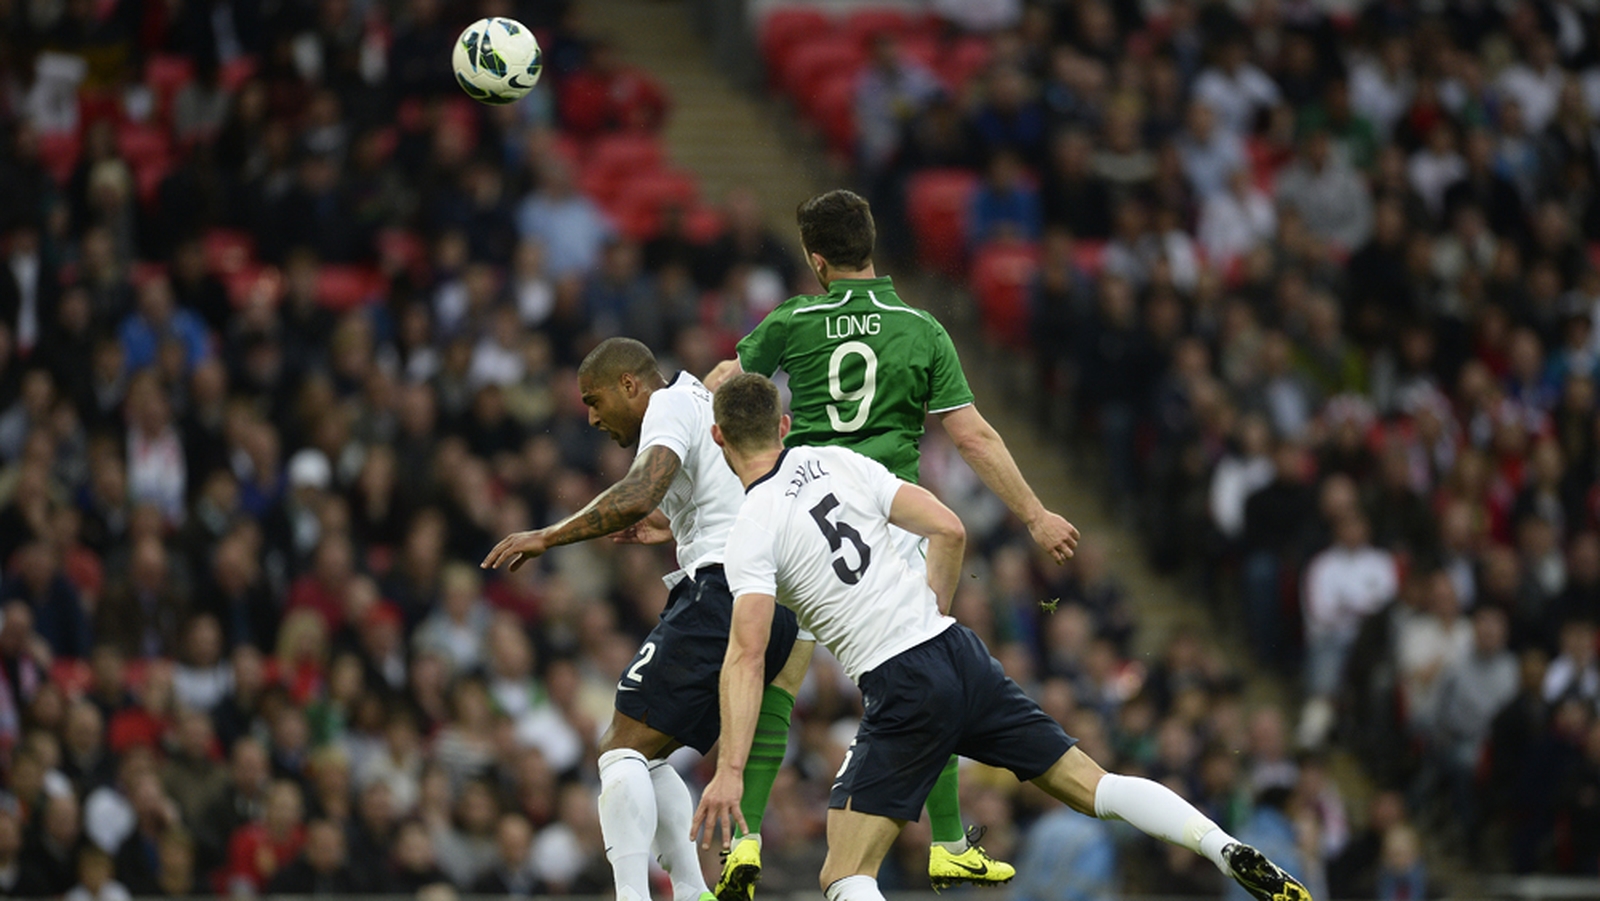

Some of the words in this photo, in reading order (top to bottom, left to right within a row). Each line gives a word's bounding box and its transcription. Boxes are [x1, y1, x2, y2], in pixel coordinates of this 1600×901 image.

[825, 313, 881, 338] LONG
[826, 341, 878, 432] 9
[808, 492, 871, 585] 5
[626, 641, 656, 682] 2
